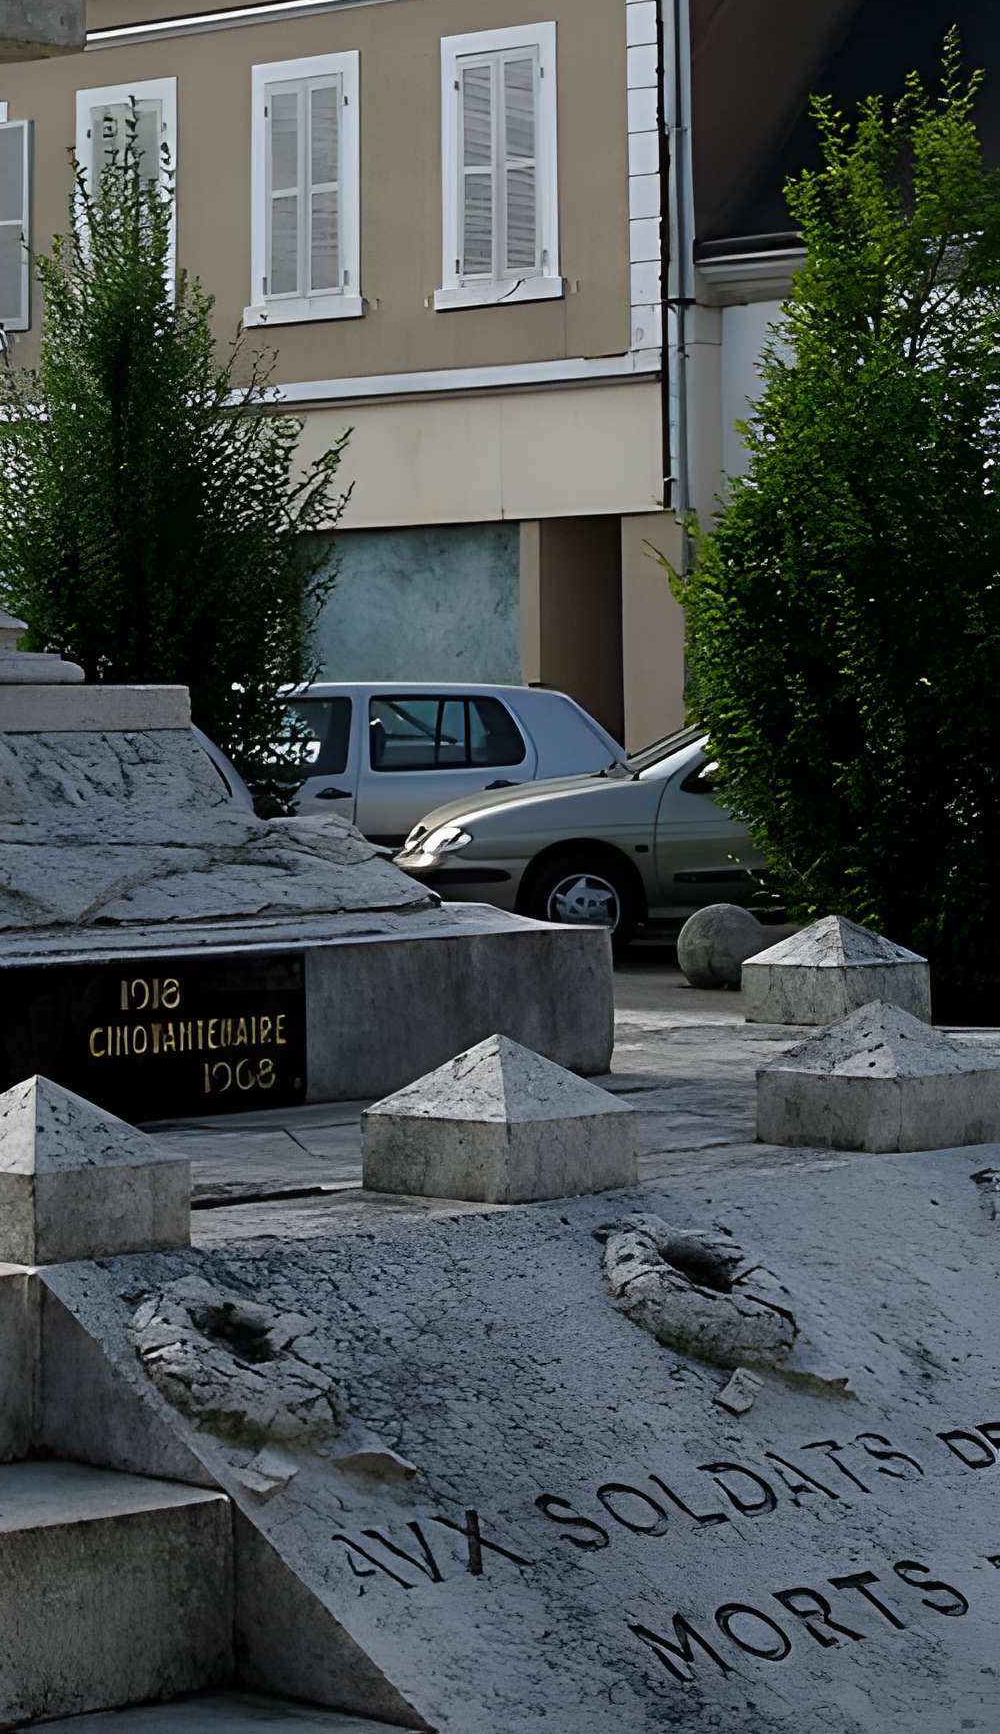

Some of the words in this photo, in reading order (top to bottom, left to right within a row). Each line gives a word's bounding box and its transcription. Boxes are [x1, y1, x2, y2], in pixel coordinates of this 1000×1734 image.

[120, 978, 182, 1010] 1918
[204, 1058, 277, 1094] 1968
[535, 1432, 925, 1552] SOLDATS
[628, 1559, 969, 1683] MORTS
